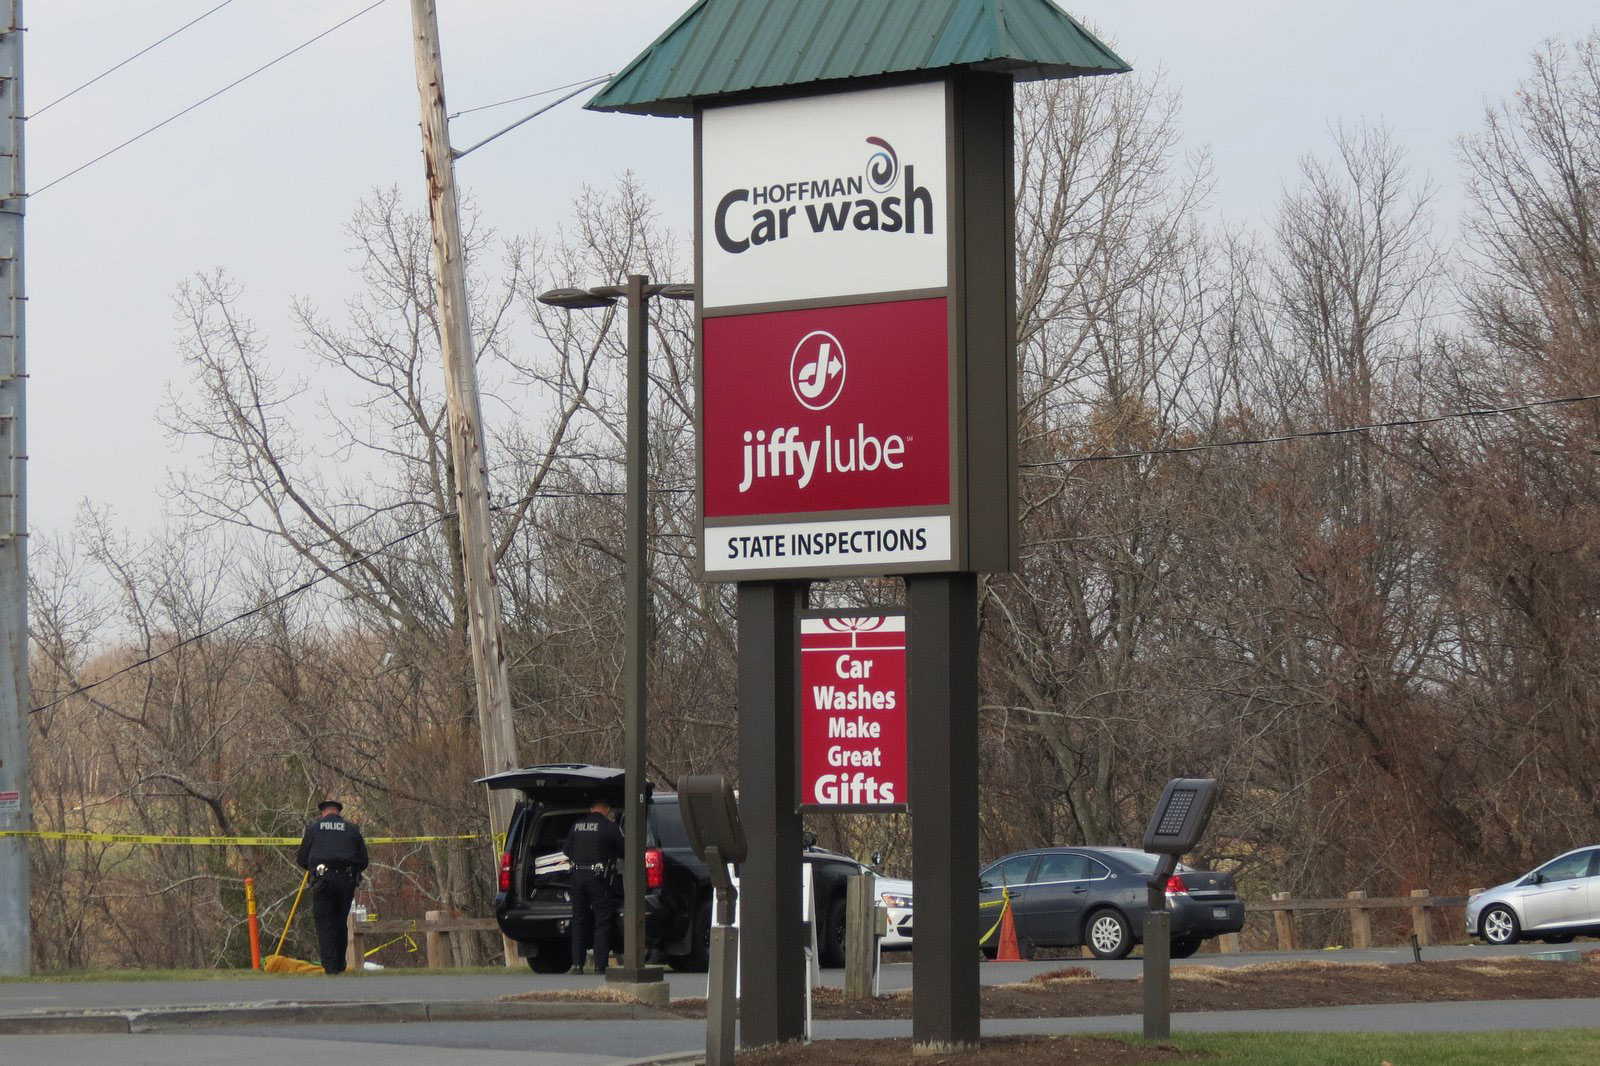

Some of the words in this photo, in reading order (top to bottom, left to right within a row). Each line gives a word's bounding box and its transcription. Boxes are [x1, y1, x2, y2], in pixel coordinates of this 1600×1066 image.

[752, 175, 863, 205] HOFFMAN
[728, 535, 786, 559] STATE
[791, 527, 928, 556] INSPECTIONS
[835, 654, 873, 679] Car
[812, 684, 896, 710] Washes
[828, 715, 881, 738] Make
[827, 745, 881, 767] Great
[814, 772, 895, 805] Gifts
[320, 821, 345, 831] POLICE
[574, 822, 599, 832] POLICE
